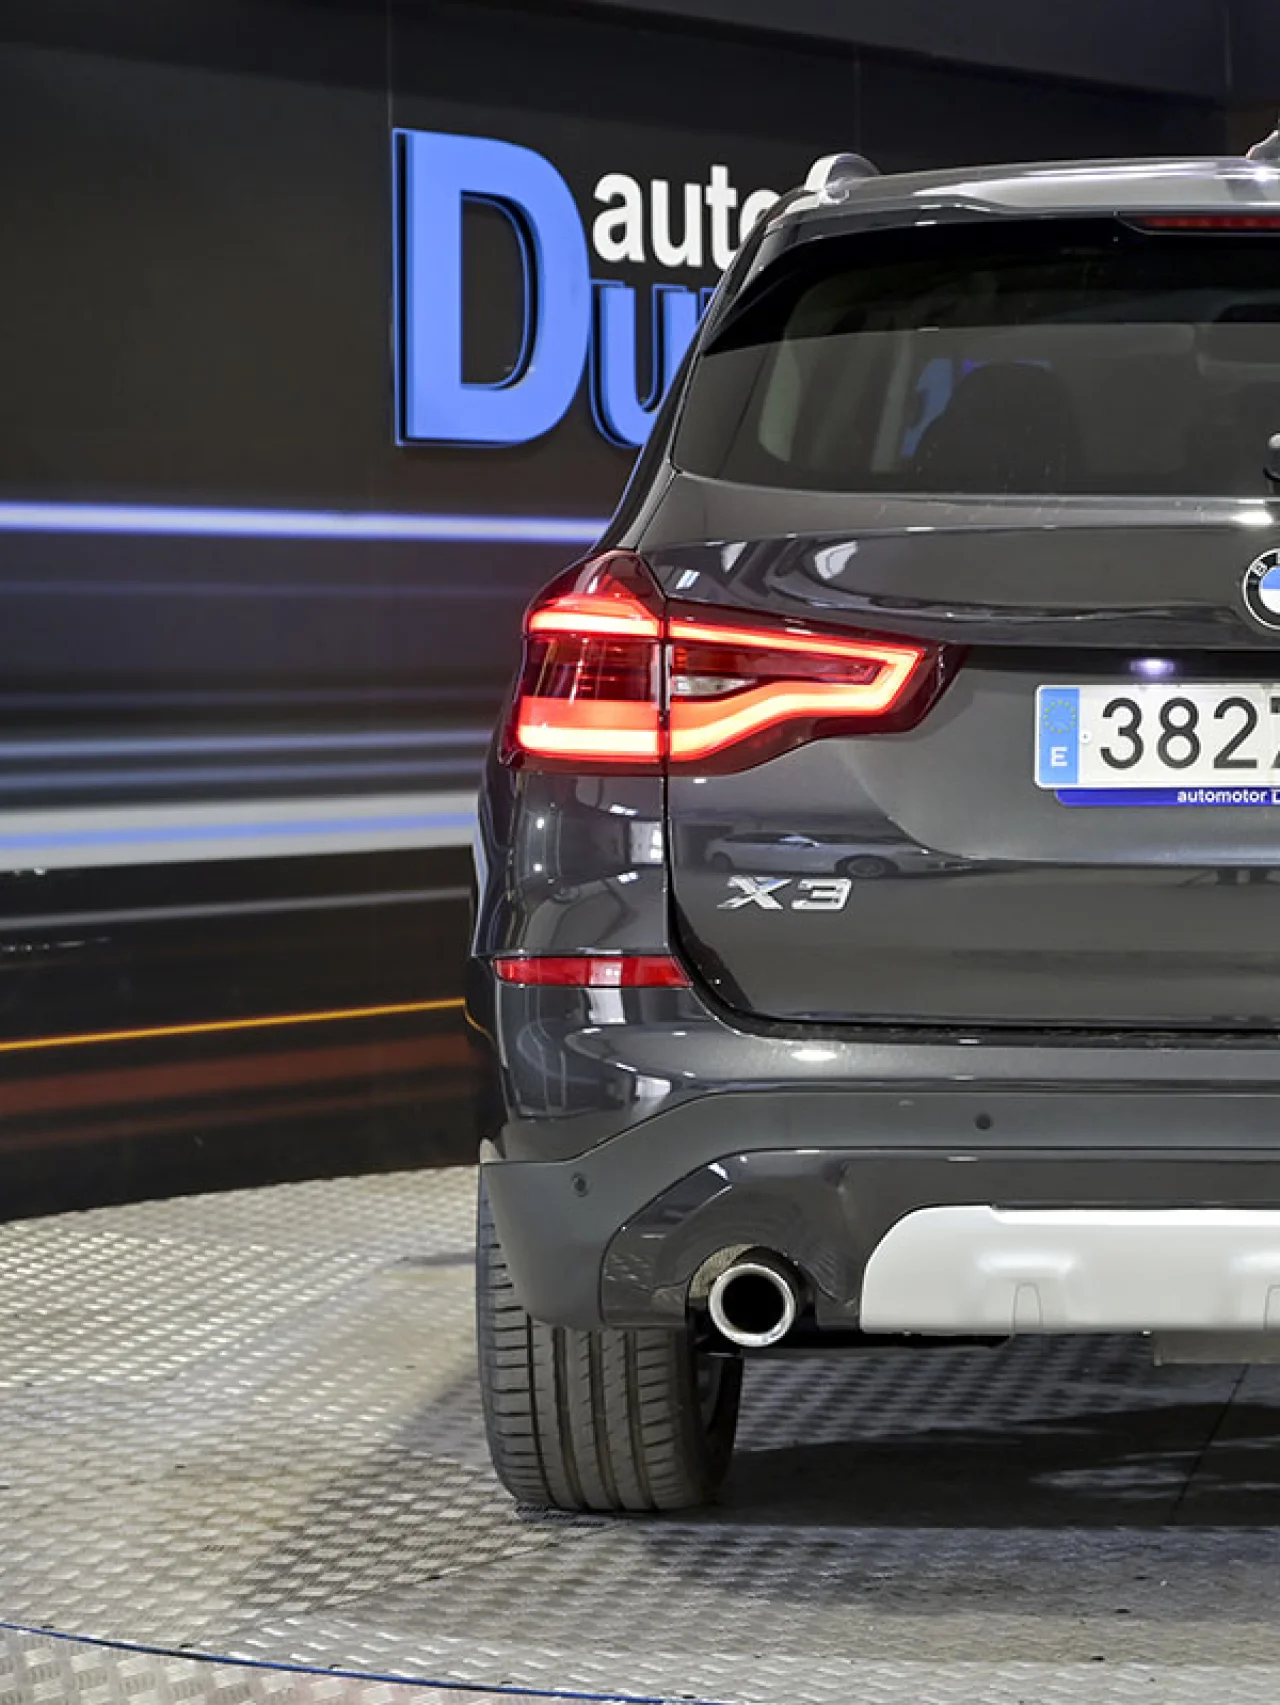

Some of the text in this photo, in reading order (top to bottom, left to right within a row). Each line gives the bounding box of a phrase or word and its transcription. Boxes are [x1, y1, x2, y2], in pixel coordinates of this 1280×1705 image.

[1050, 745, 1069, 768] E
[1177, 788, 1268, 804] automotor
[716, 876, 852, 910] X3
